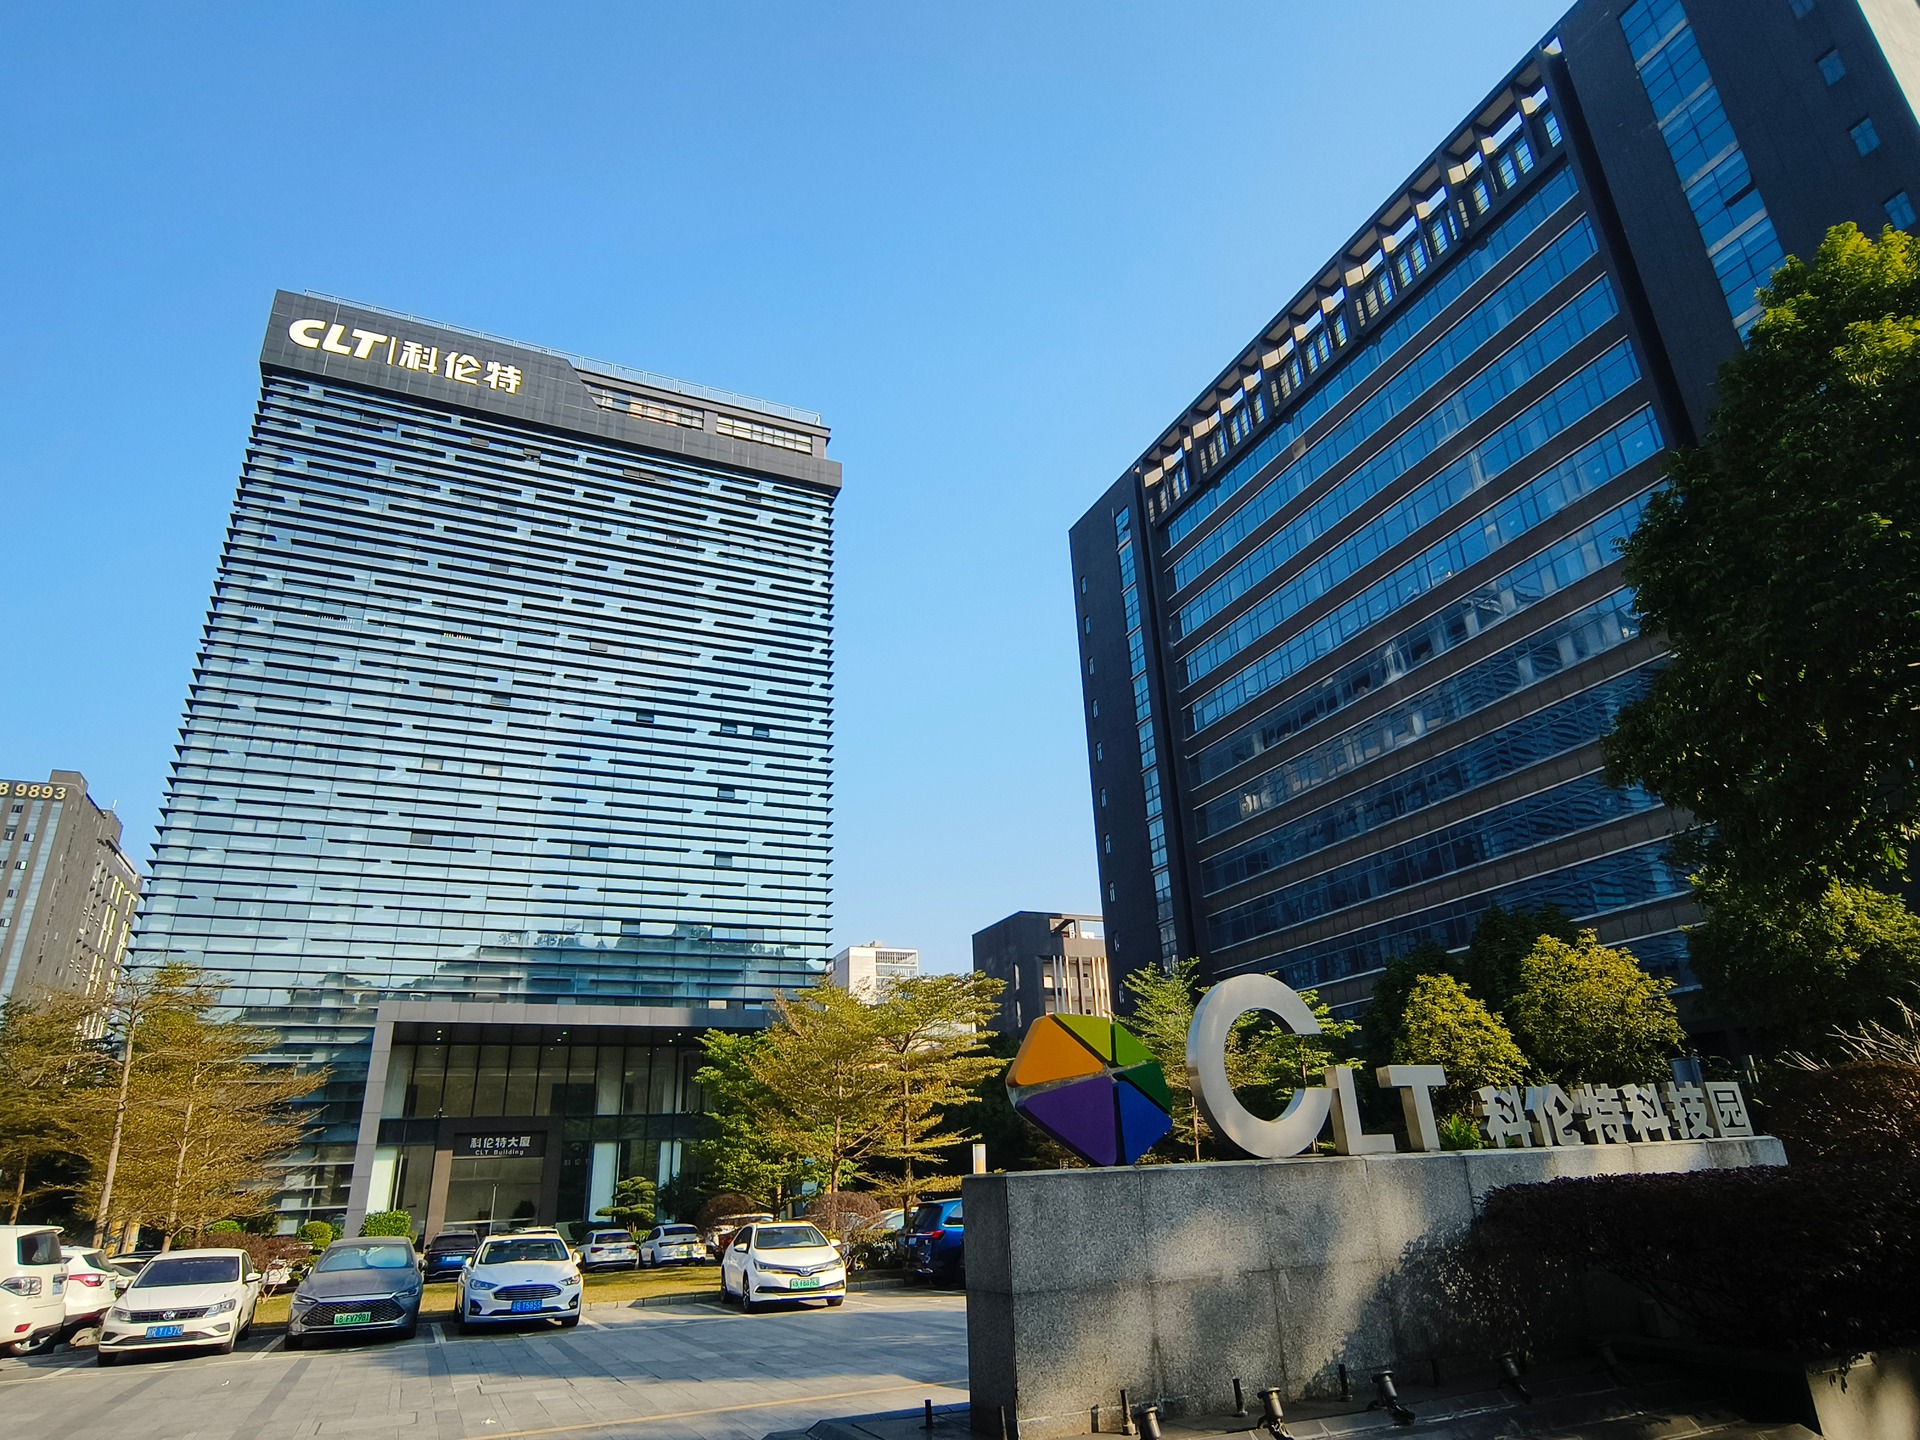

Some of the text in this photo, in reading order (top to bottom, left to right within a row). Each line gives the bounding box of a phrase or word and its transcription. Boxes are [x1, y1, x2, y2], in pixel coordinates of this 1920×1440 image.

[288, 318, 523, 395] CLT 科伦特
[15, 783, 67, 800] 9893
[1186, 973, 1447, 1159] CLT
[469, 1136, 531, 1149] 科伦特大厦
[1473, 1081, 1754, 1148] 科伦特科技园
